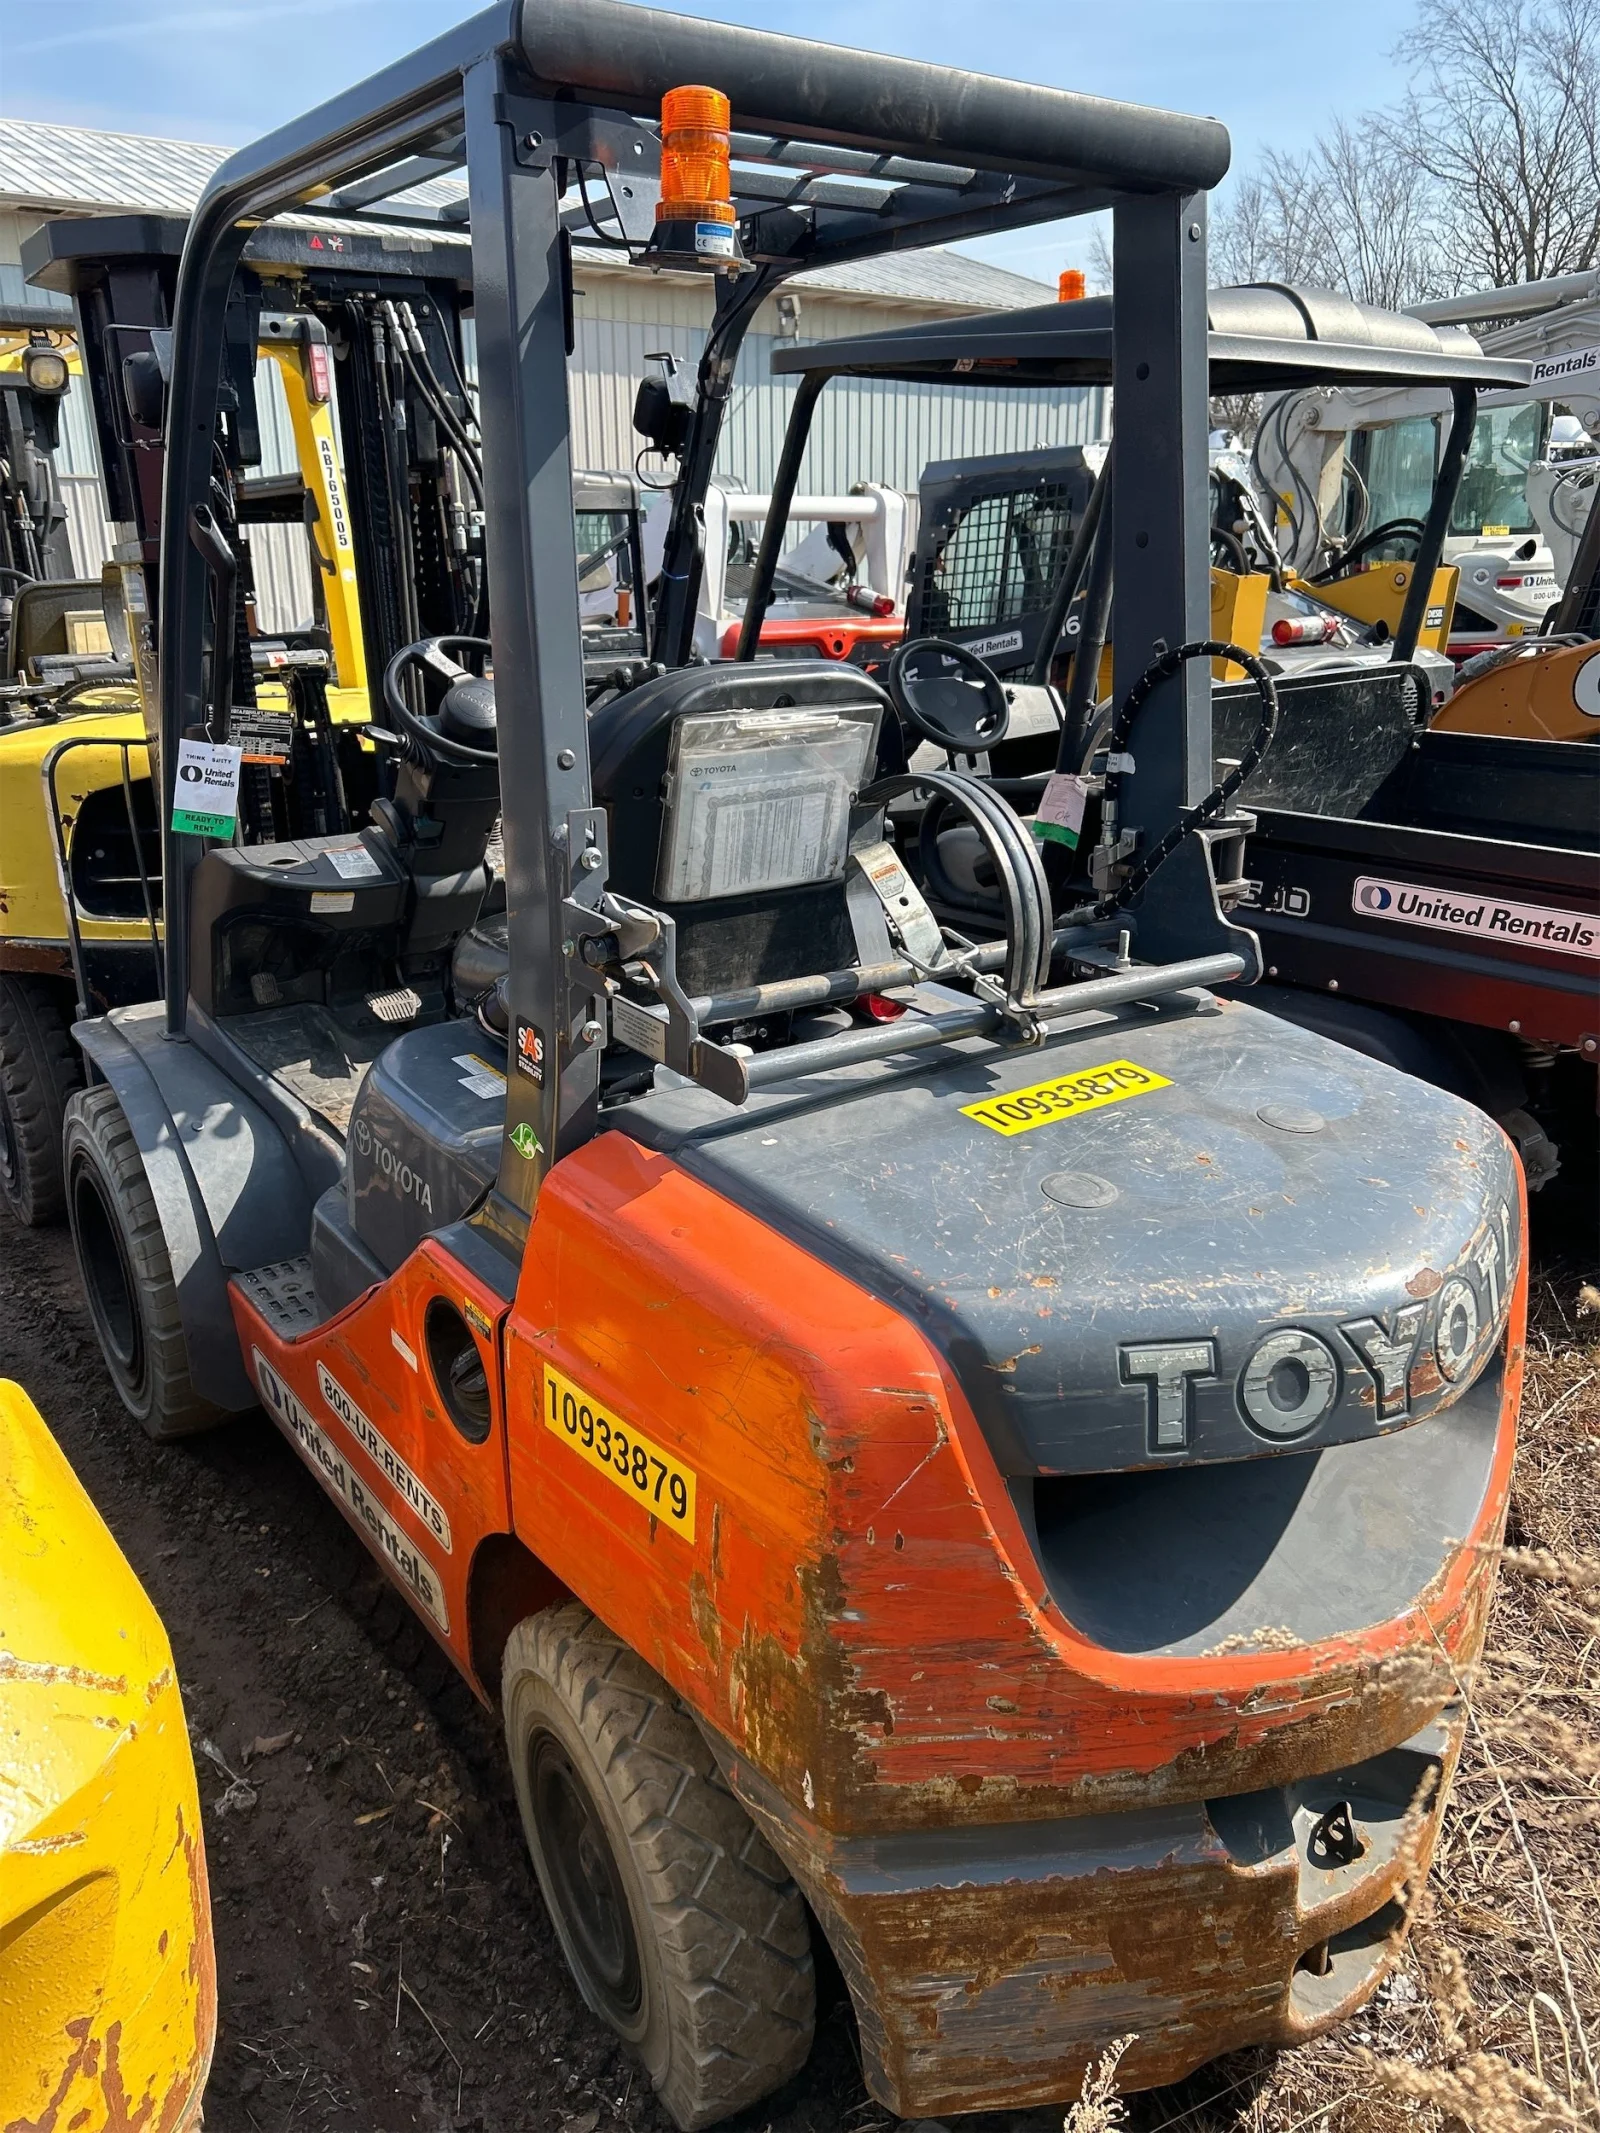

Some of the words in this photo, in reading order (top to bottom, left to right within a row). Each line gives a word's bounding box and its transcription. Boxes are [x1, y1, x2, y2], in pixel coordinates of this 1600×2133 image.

[1533, 352, 1597, 380] Rentals
[321, 440, 348, 546] AB765005
[986, 636, 1018, 653] Rentals
[186, 753, 206, 762] THINK
[205, 767, 233, 779] United
[704, 764, 737, 775] TOYOTA
[203, 776, 235, 788] Rentals
[185, 814, 212, 824] READY
[193, 825, 215, 833] RENT
[1396, 891, 1485, 927] United
[1488, 907, 1595, 947] Rentals
[517, 1026, 544, 1064] SAS
[972, 1067, 1151, 1127] 10933879
[372, 1137, 433, 1215] TOYOTA
[323, 1376, 443, 1535] 800-UR-RENTS
[547, 1378, 688, 1520] 10933879
[284, 1391, 346, 1494] United
[351, 1483, 434, 1606] Rentals
